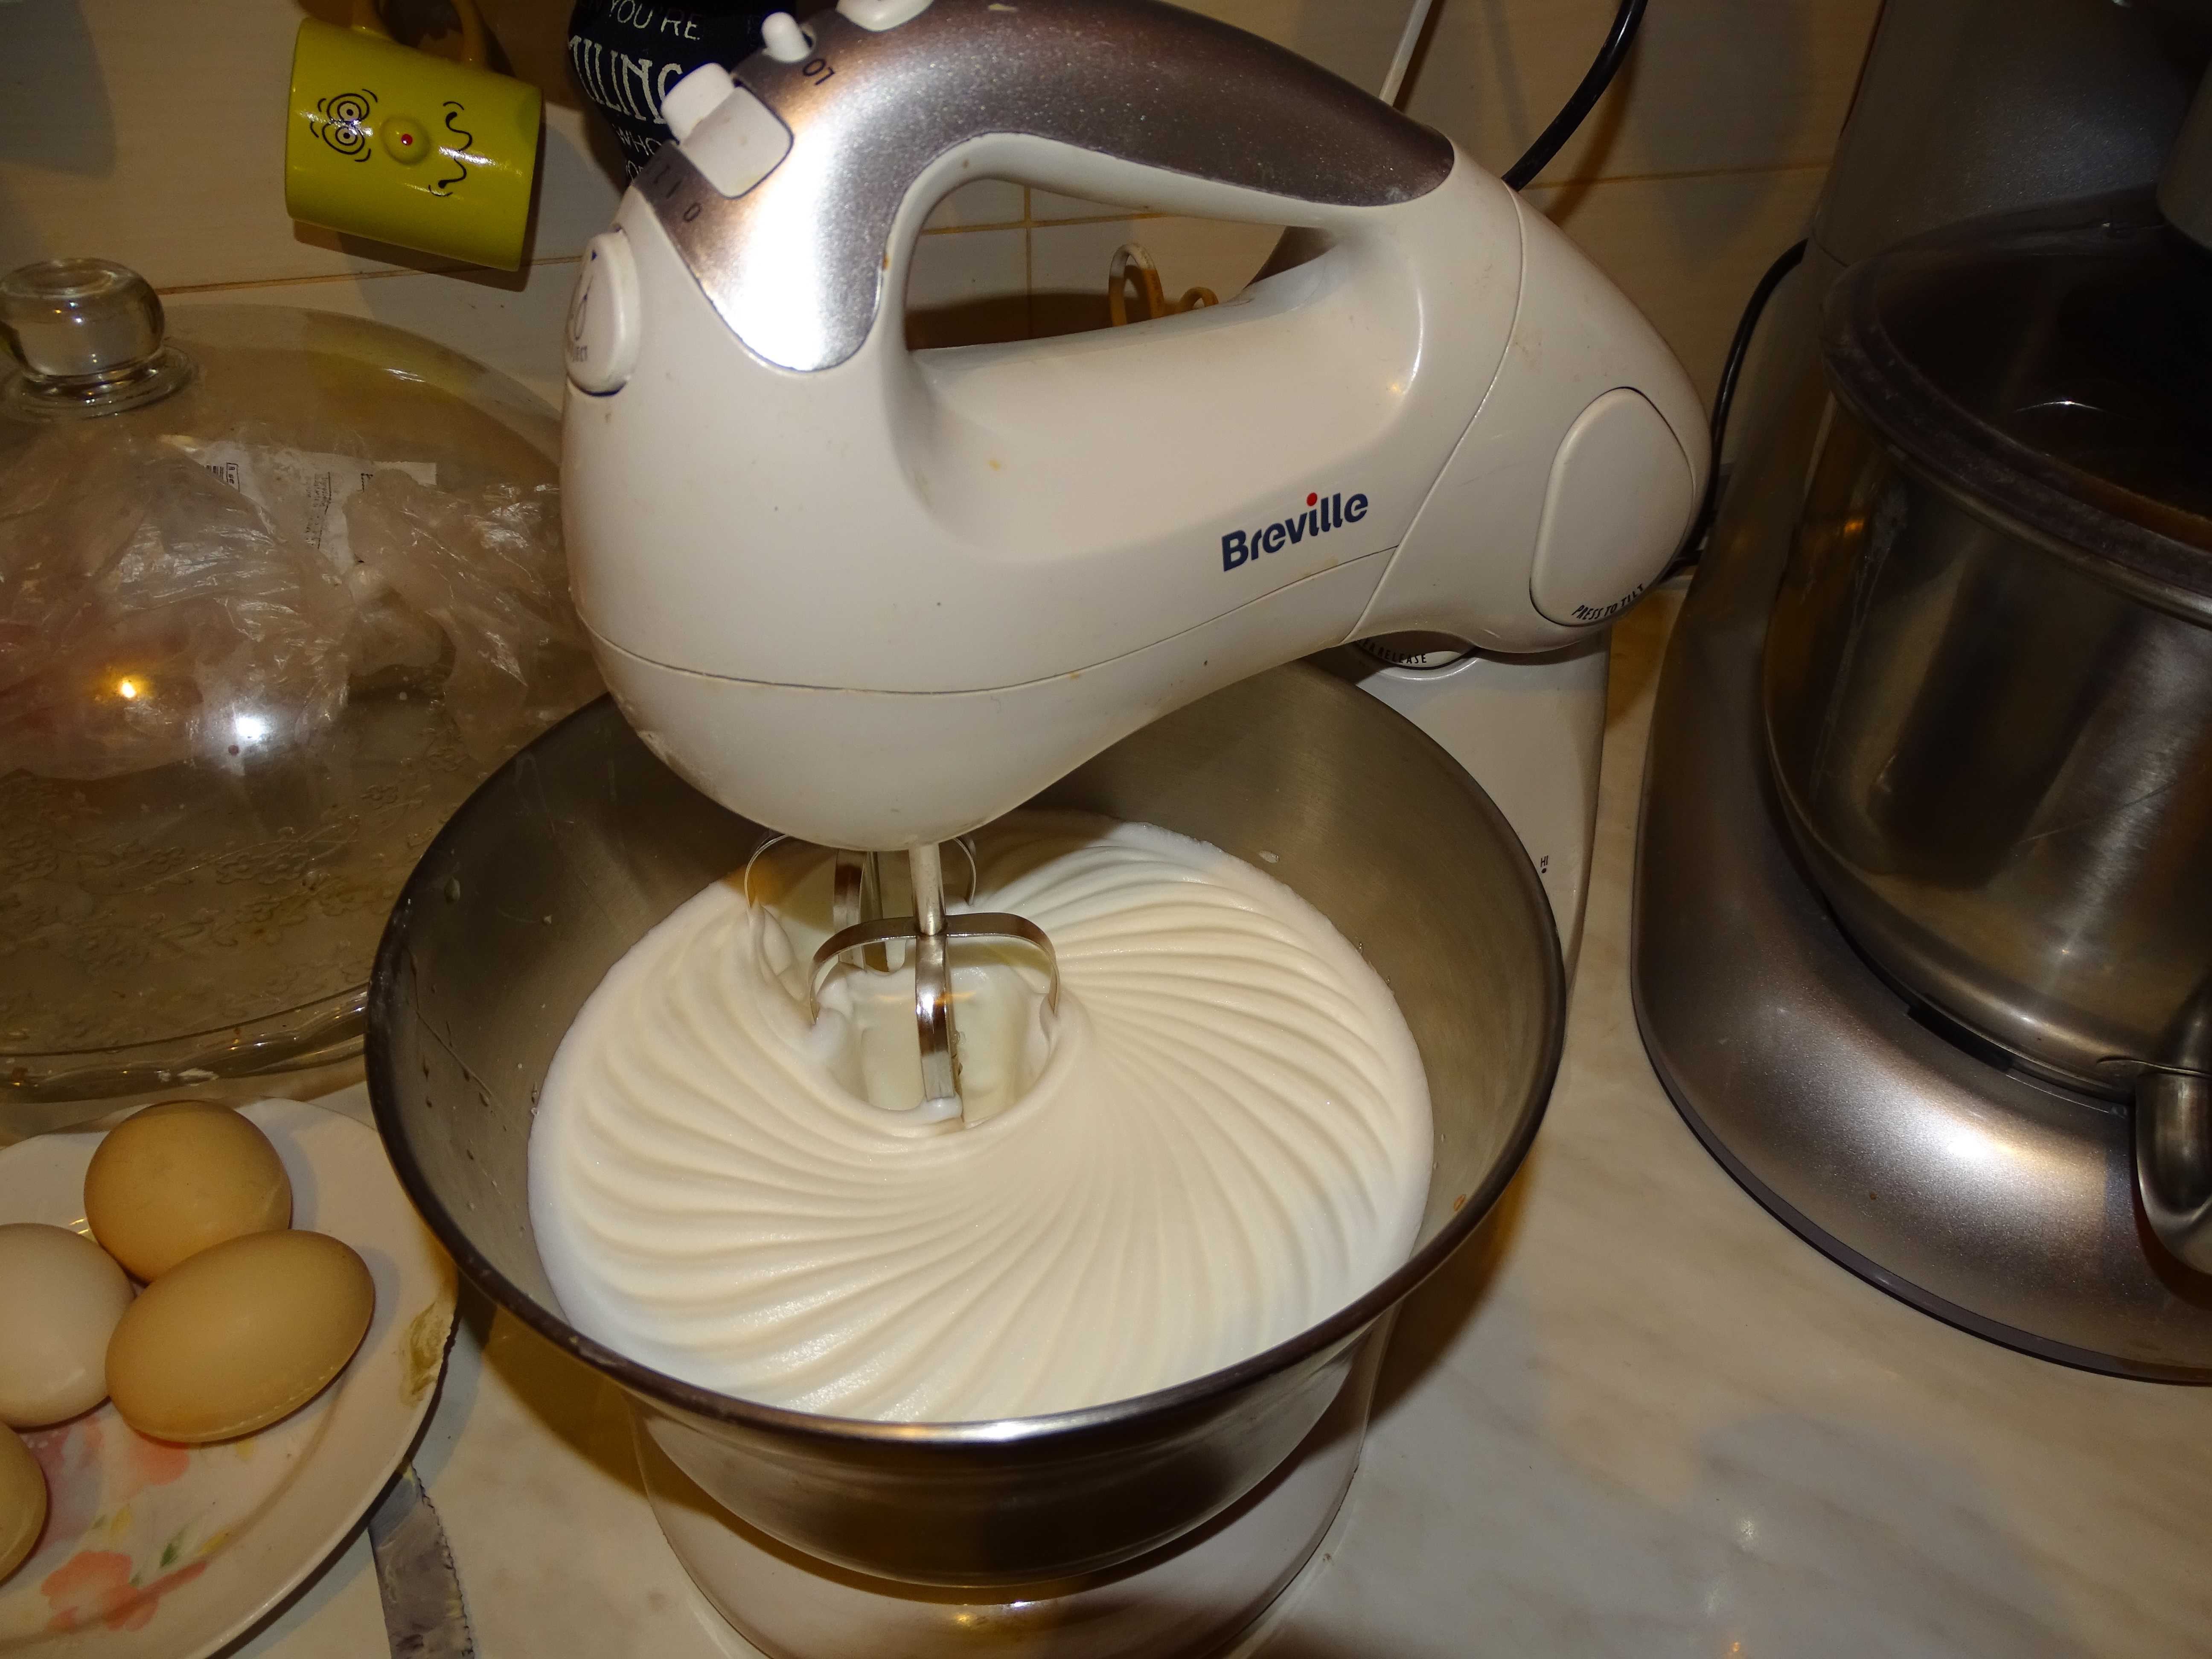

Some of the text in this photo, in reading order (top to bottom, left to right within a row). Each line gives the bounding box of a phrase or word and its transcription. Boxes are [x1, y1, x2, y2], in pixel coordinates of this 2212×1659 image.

[1222, 492, 1368, 572] Breville
[1571, 583, 1644, 620] PRESS TO TILT
[1377, 646, 1427, 664] RELEASE
[1540, 855, 1548, 867] HI
